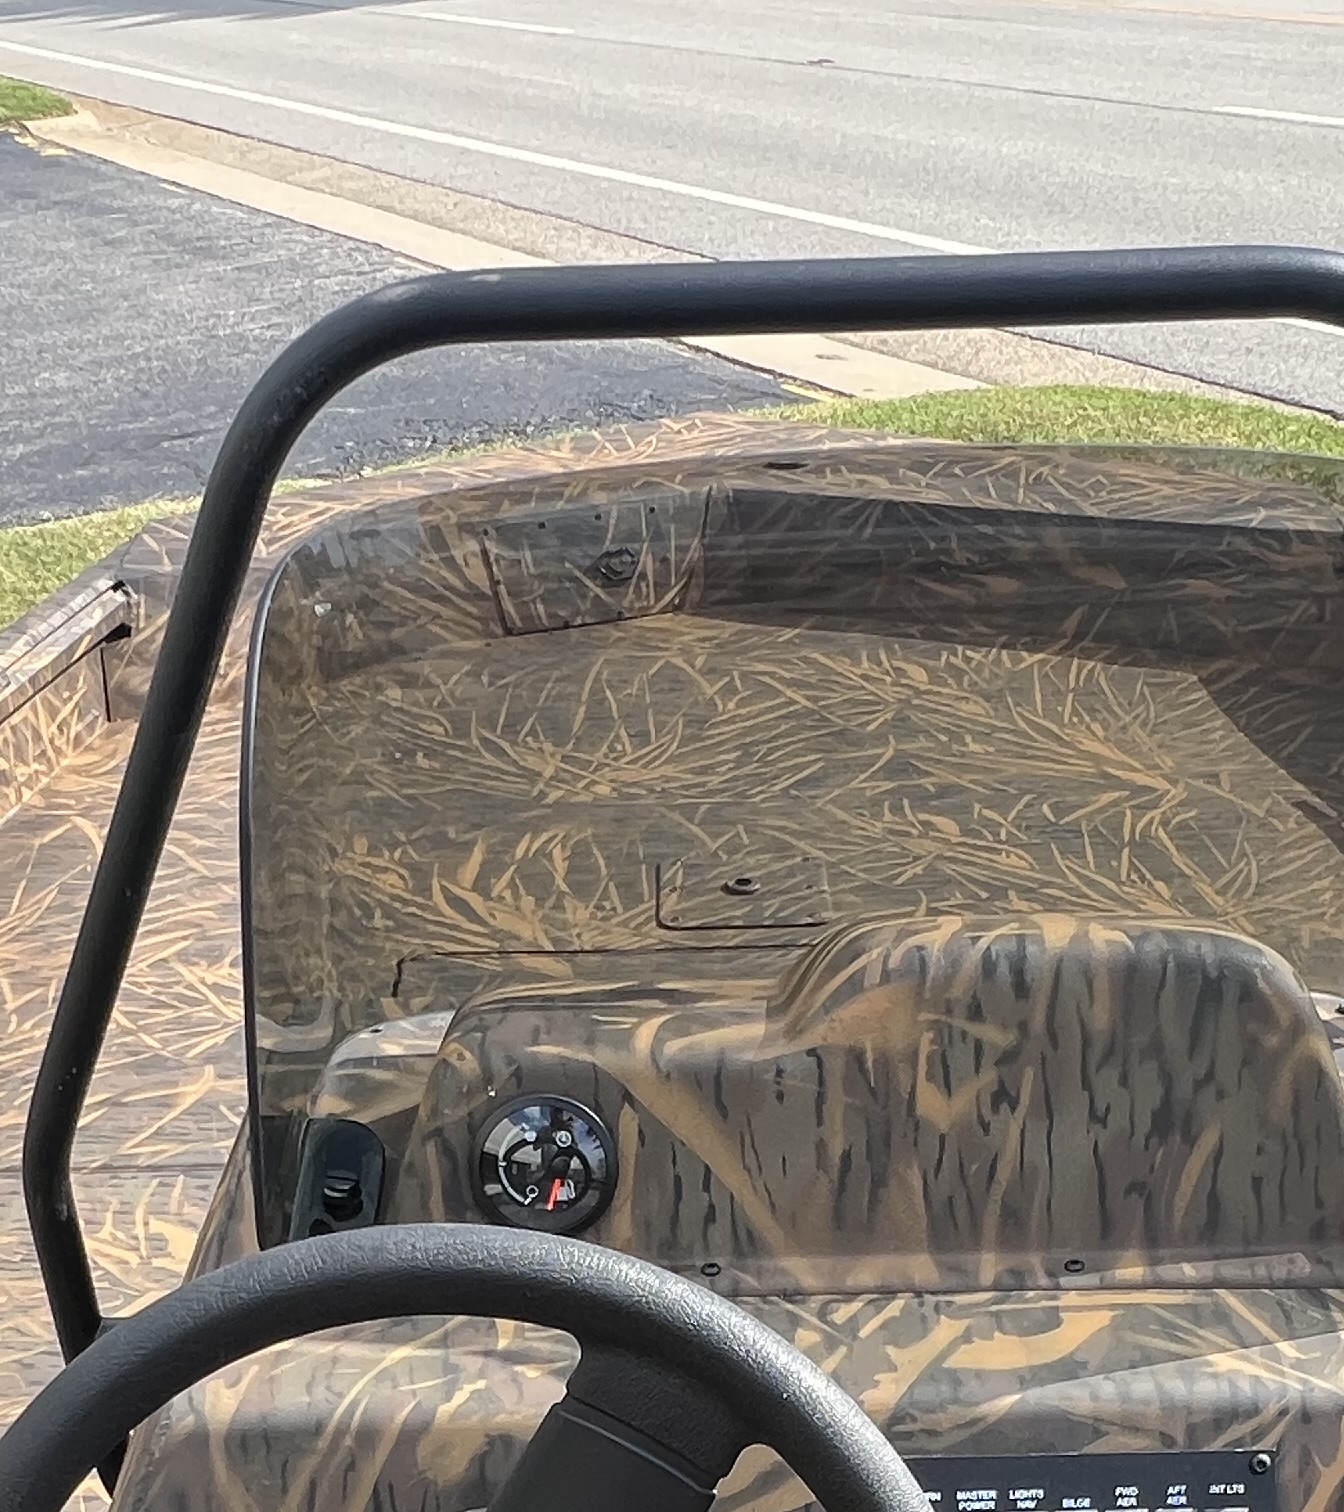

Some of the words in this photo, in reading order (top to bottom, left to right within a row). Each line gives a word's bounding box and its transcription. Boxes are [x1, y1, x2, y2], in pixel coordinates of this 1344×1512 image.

[956, 1490, 997, 1500] MASTER
[1009, 1489, 1044, 1500] LIGHTS
[958, 1501, 996, 1511] POWER
